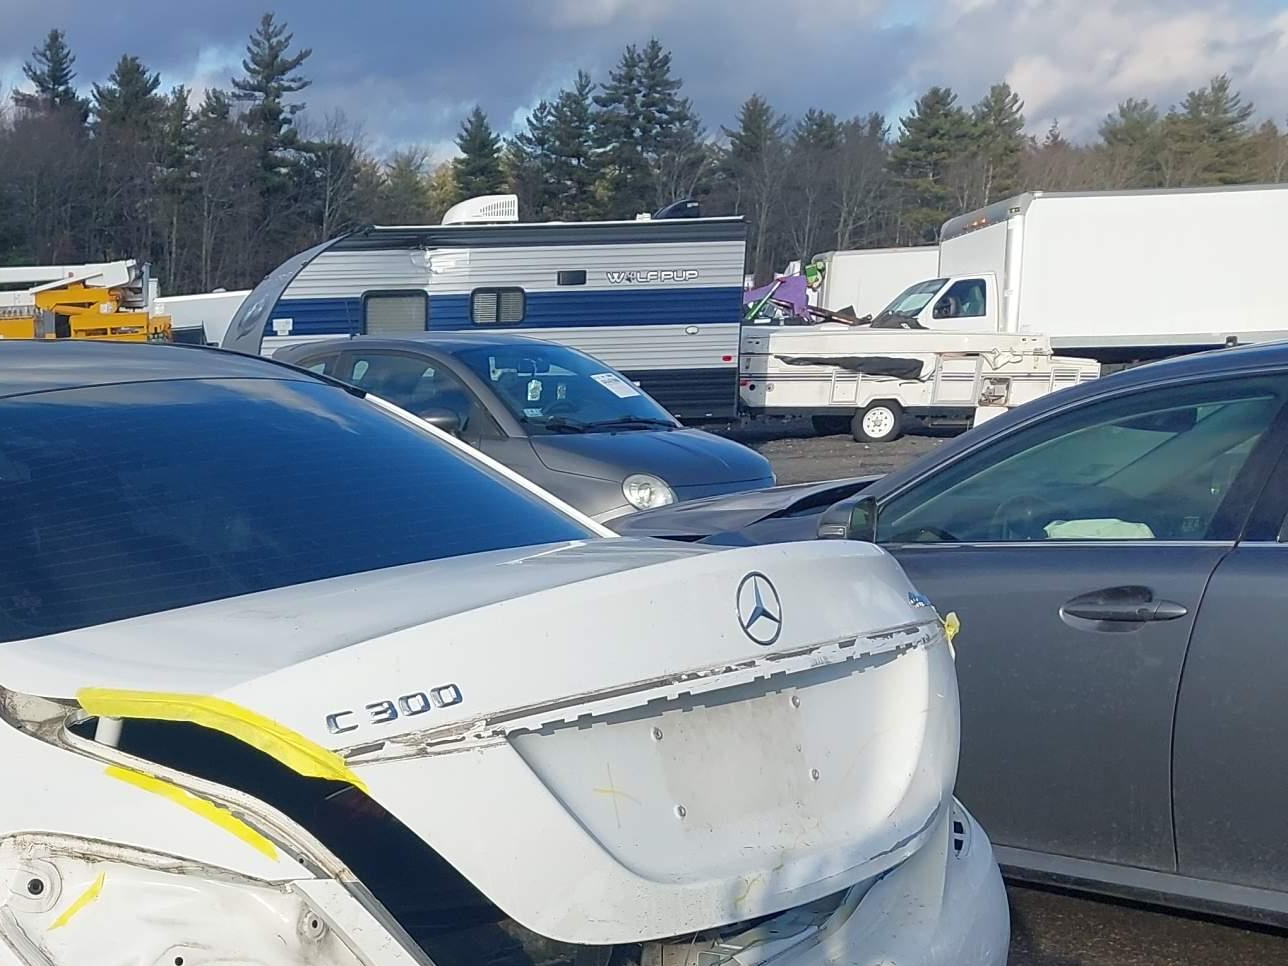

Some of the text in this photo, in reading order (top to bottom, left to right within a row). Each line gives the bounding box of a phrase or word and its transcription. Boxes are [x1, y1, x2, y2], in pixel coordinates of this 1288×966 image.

[606, 269, 699, 284] WLF PUP
[326, 683, 464, 735] C 300
